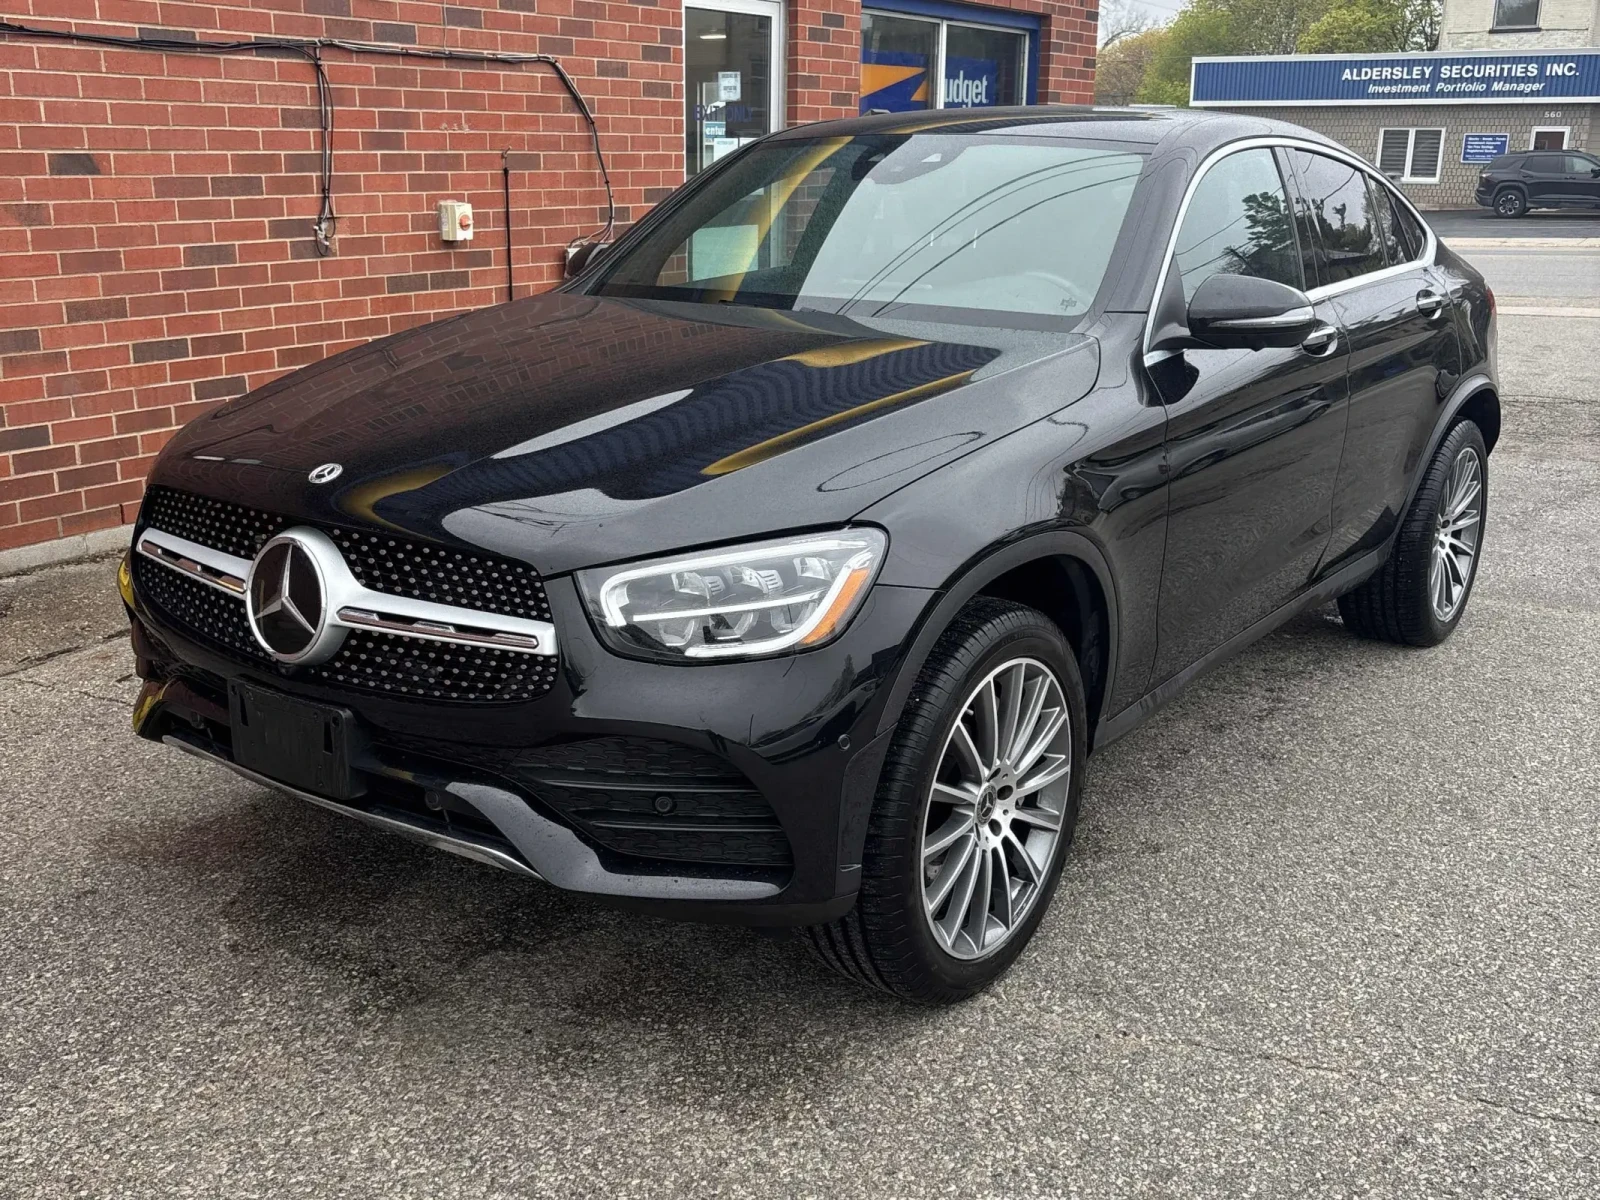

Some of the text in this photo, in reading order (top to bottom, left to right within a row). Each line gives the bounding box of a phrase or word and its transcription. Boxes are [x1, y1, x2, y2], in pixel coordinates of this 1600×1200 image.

[1342, 62, 1580, 80] ALDERSLEY SECURITIES INC.
[944, 70, 990, 108] udget
[1368, 80, 1545, 94] Investment Portfolio Manager
